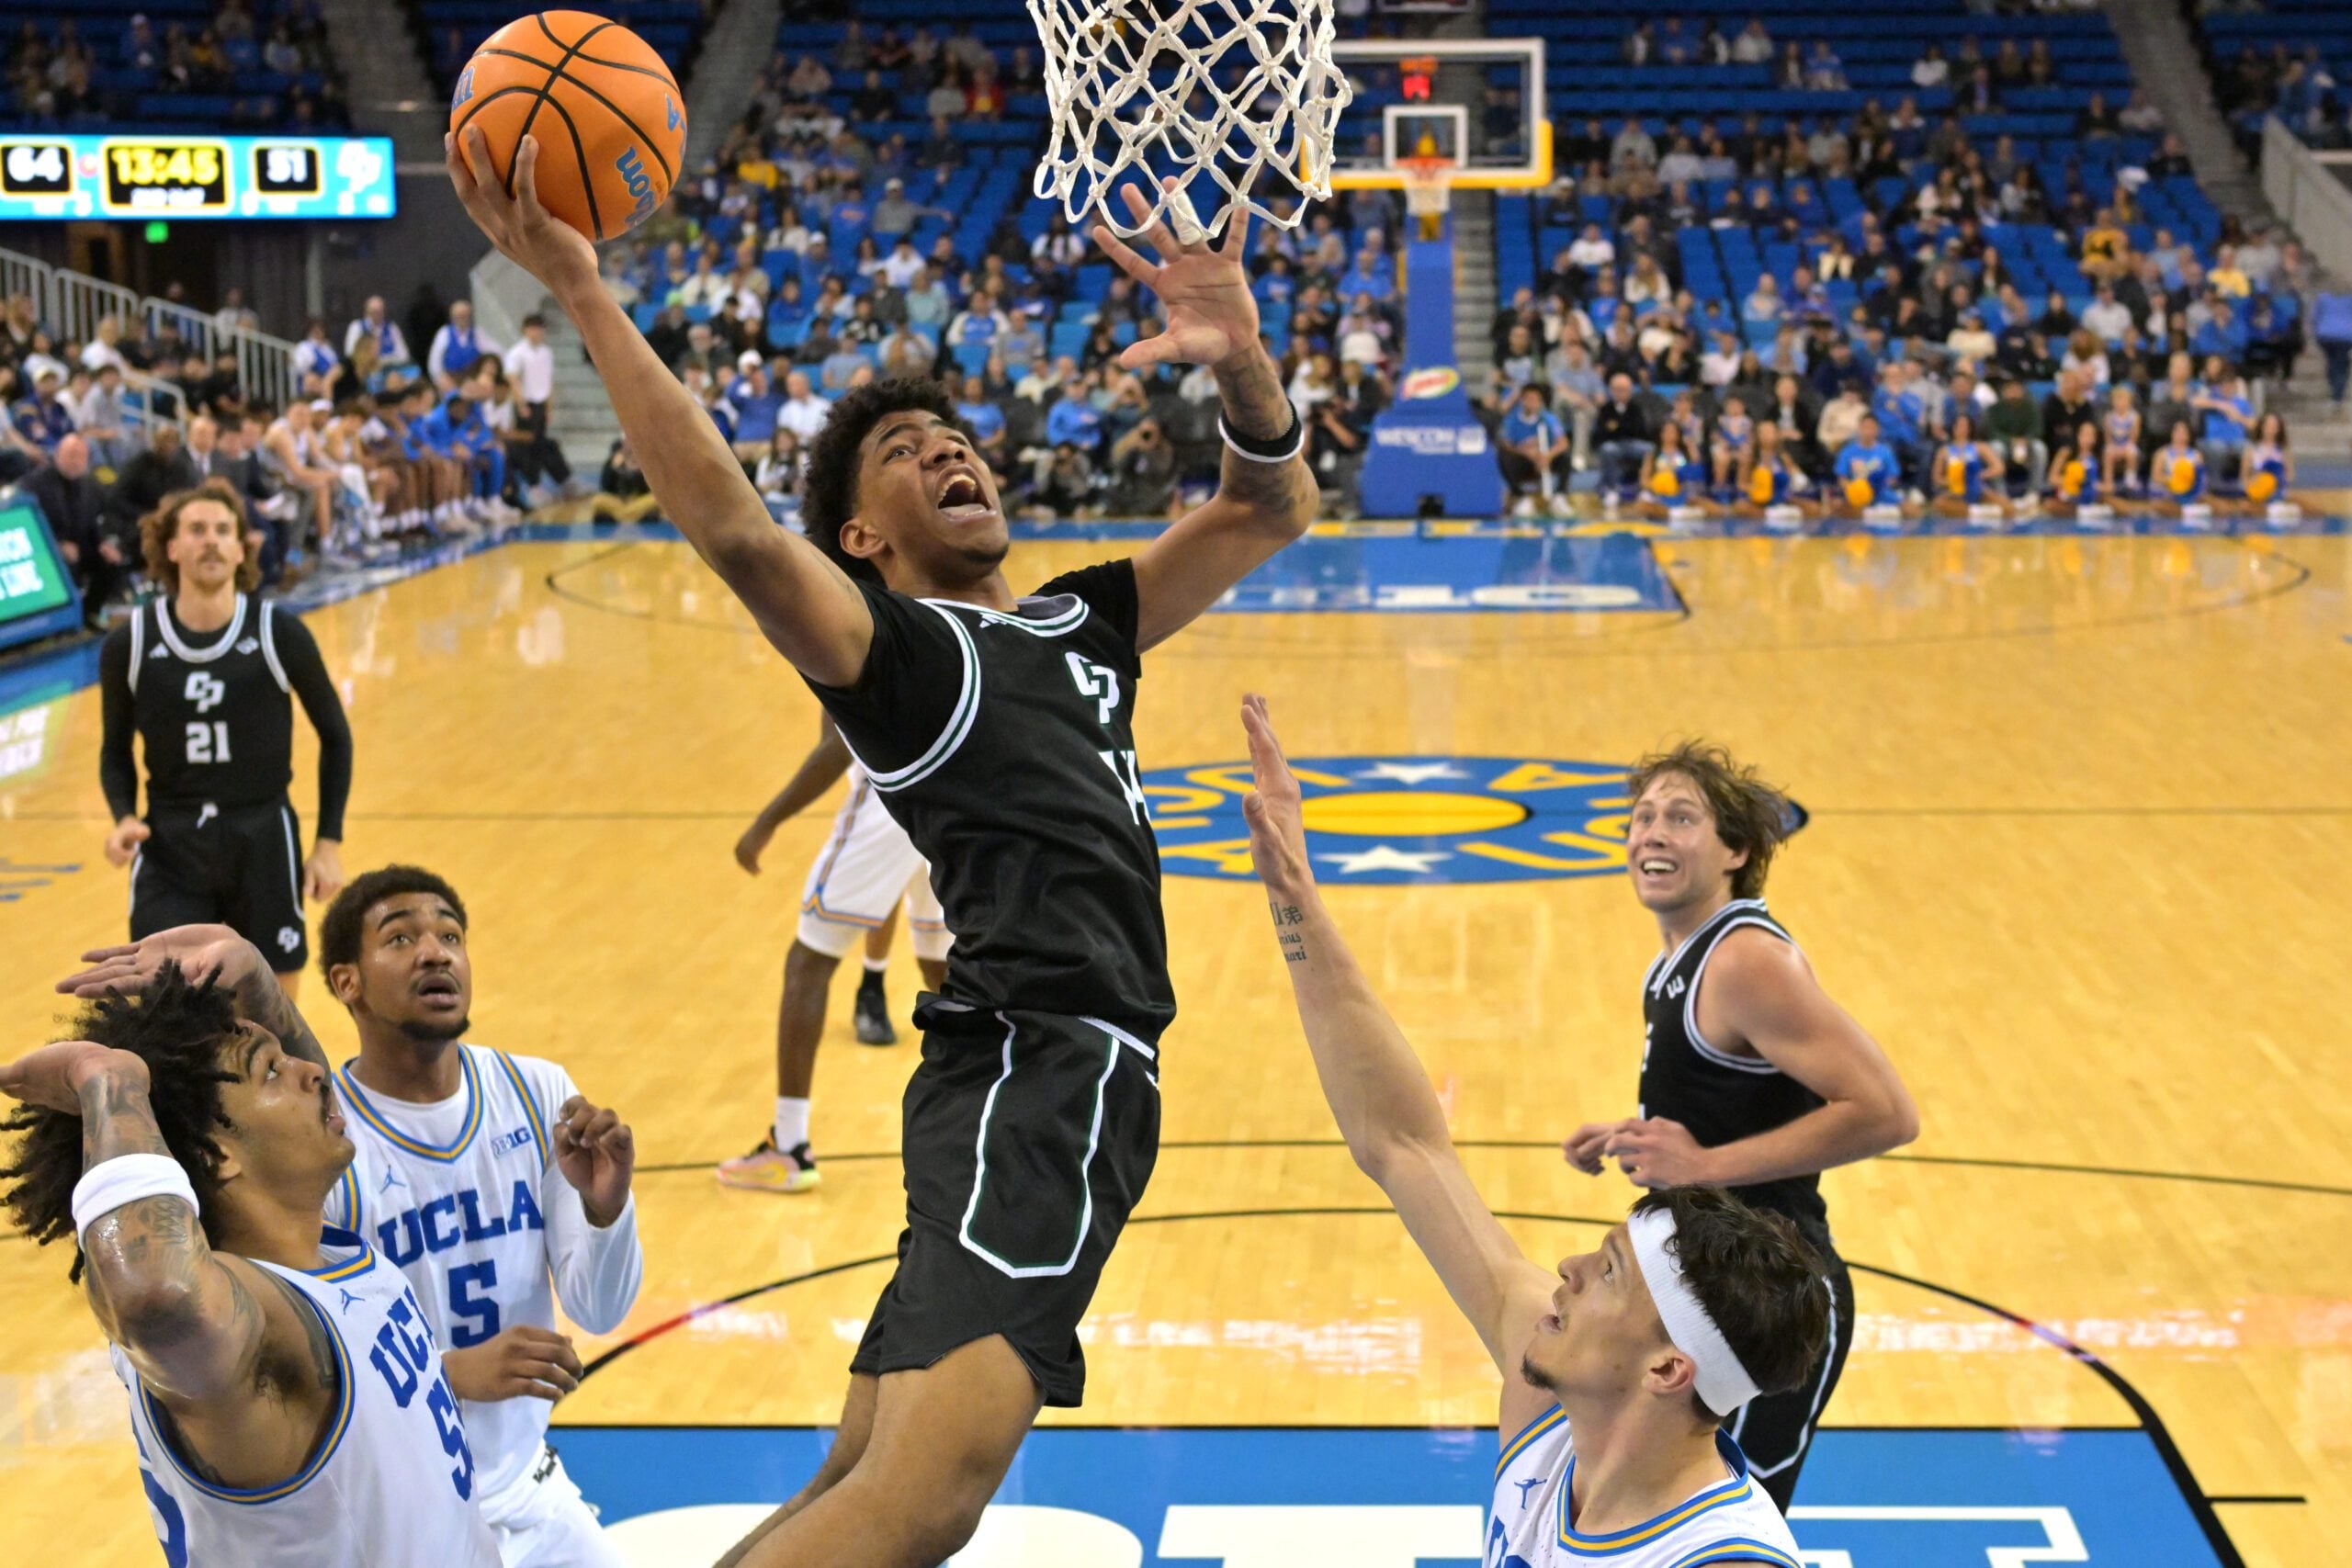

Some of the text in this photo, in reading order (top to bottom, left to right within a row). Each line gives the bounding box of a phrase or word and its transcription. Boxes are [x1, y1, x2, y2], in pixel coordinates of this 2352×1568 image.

[7, 146, 308, 185] 64 13:45 51
[185, 671, 225, 713] CP
[1064, 650, 1120, 724] CP
[186, 720, 232, 763] 21
[377, 1180, 545, 1278] UCLA
[447, 1258, 501, 1348] 5
[368, 1284, 435, 1409] UC
[425, 1361, 475, 1502] 5
